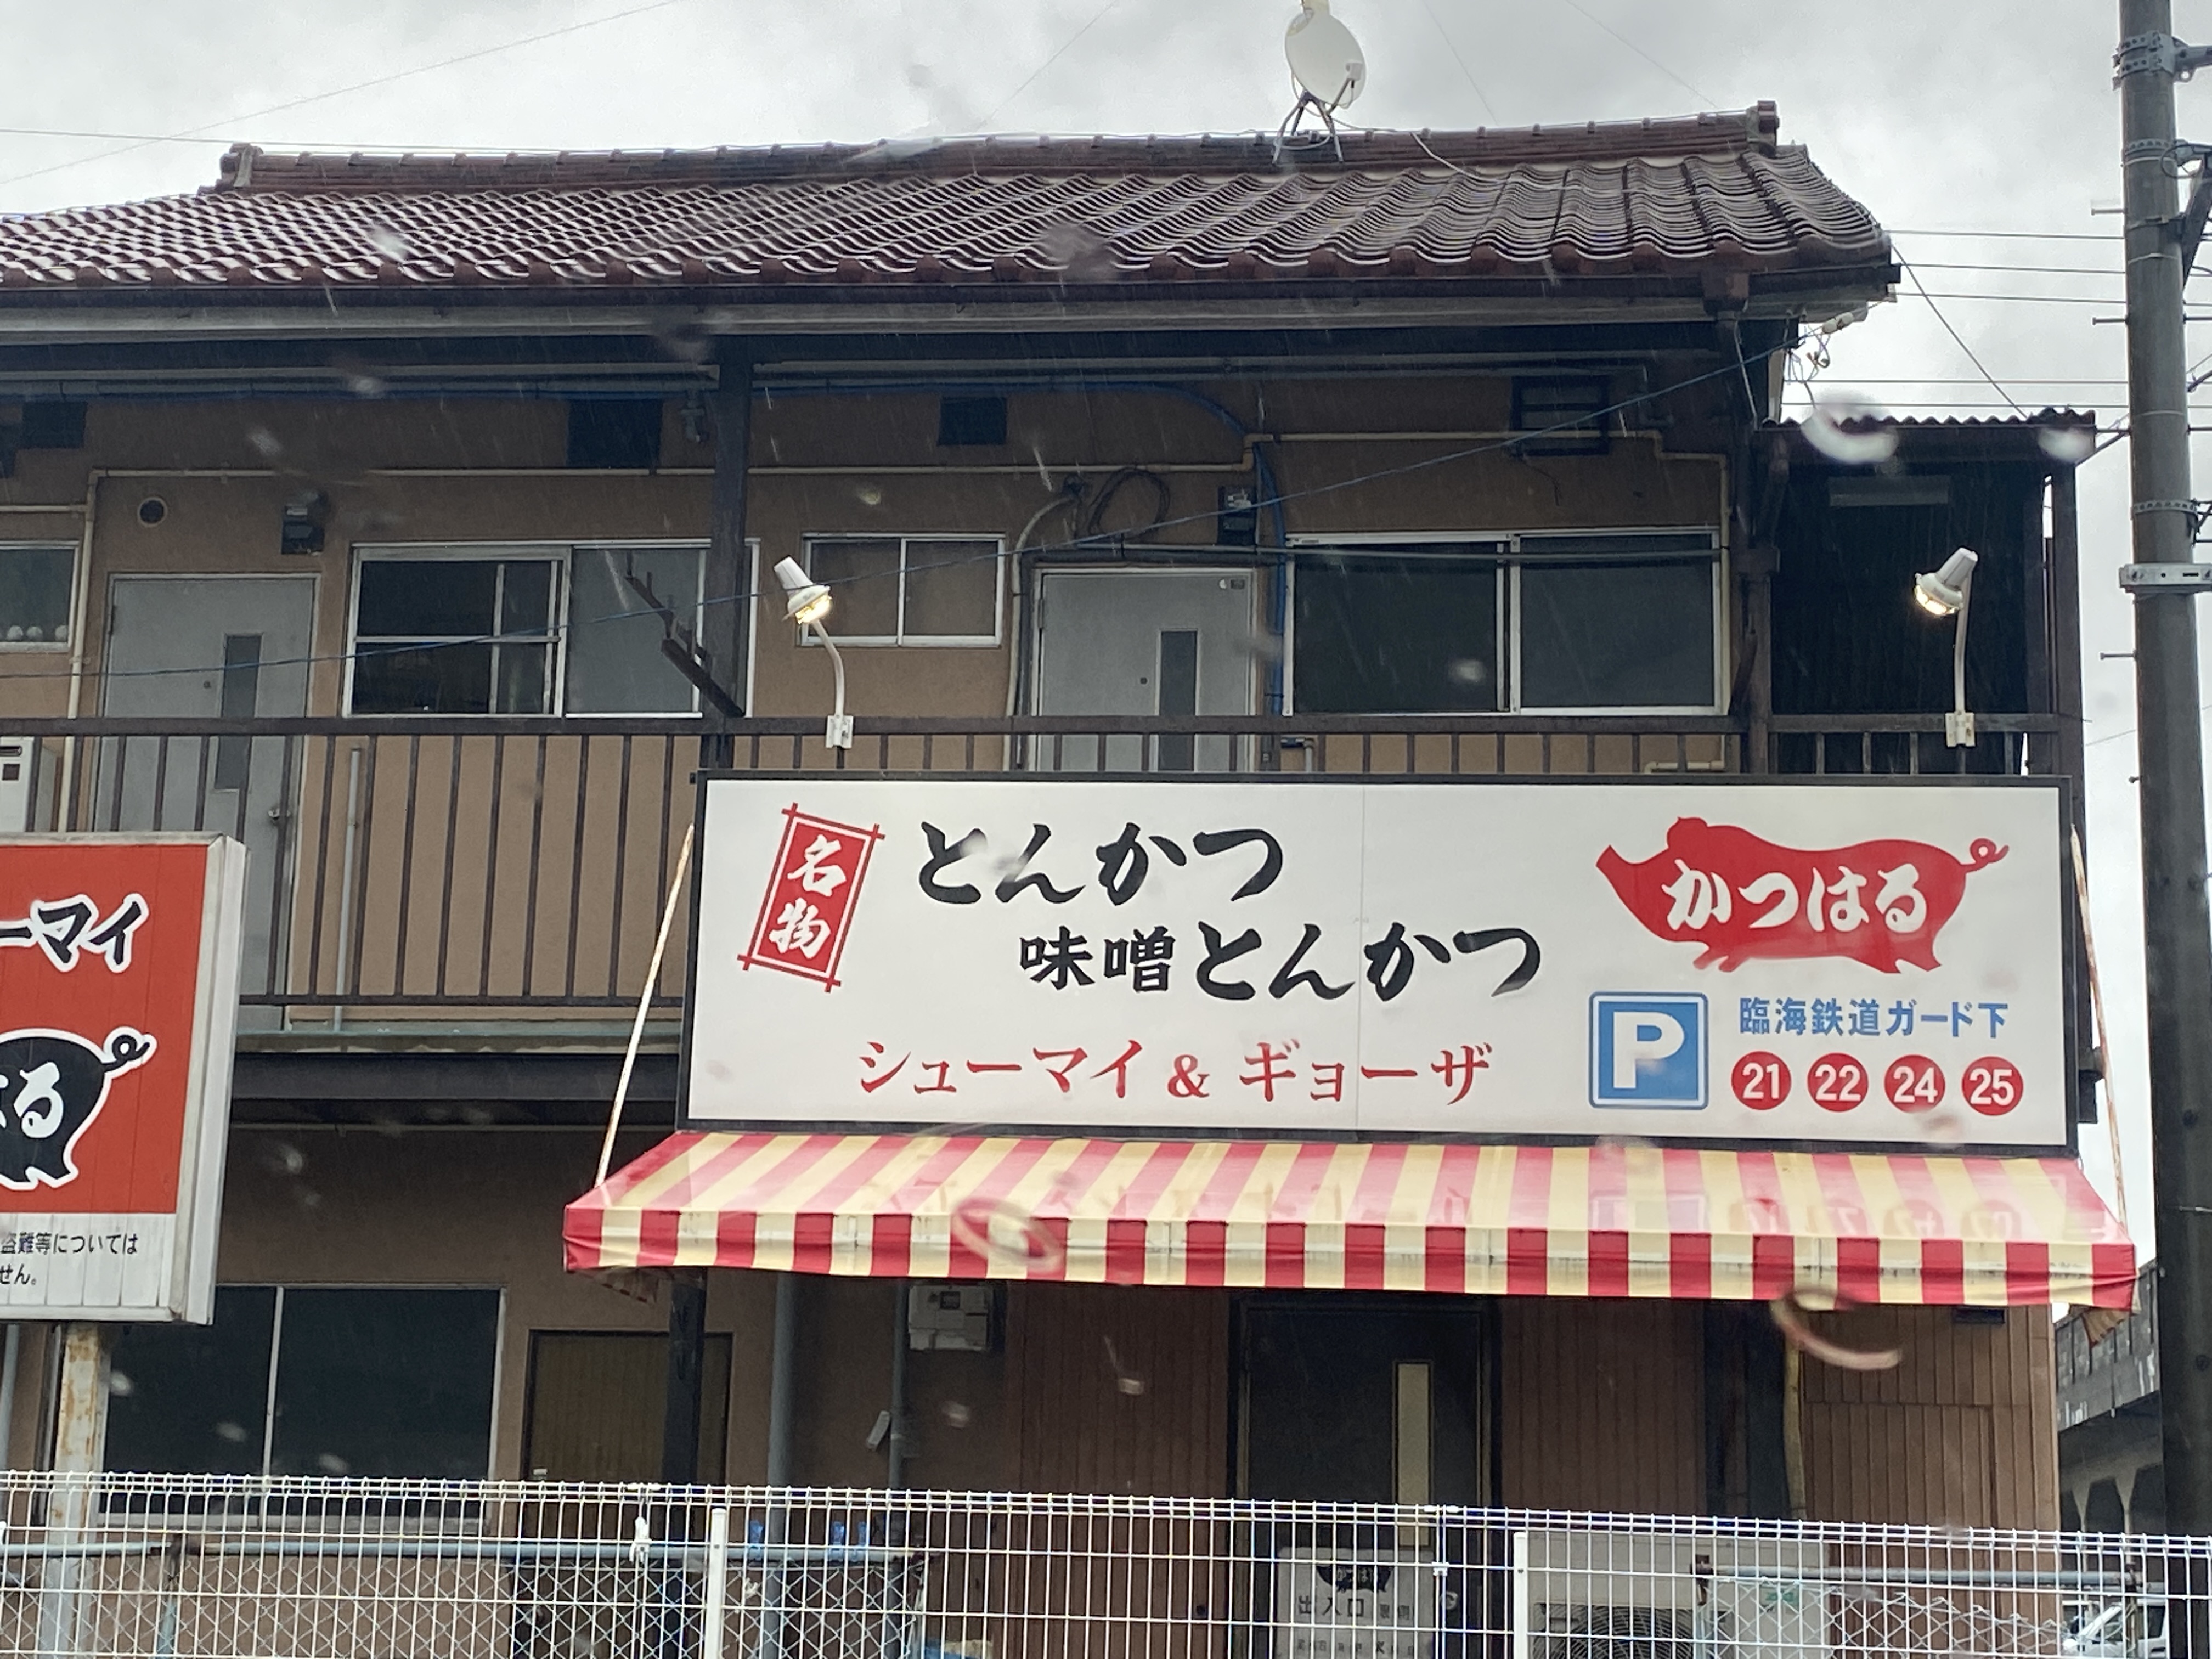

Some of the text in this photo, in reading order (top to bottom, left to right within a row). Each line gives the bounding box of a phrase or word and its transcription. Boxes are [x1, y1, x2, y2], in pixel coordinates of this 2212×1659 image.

[768, 834, 847, 958] 名物
[919, 821, 1283, 906] とんかつ
[1662, 859, 1928, 933] かつはる
[1019, 921, 1541, 1002] 味噌とんかつ
[1613, 1011, 1685, 1089] P
[1739, 997, 2009, 1037] 臨海鉄道ガード下
[859, 1038, 1493, 1105] シューマイ & ギョーザ
[1742, 1063, 2015, 1105] 21 22 24 25
